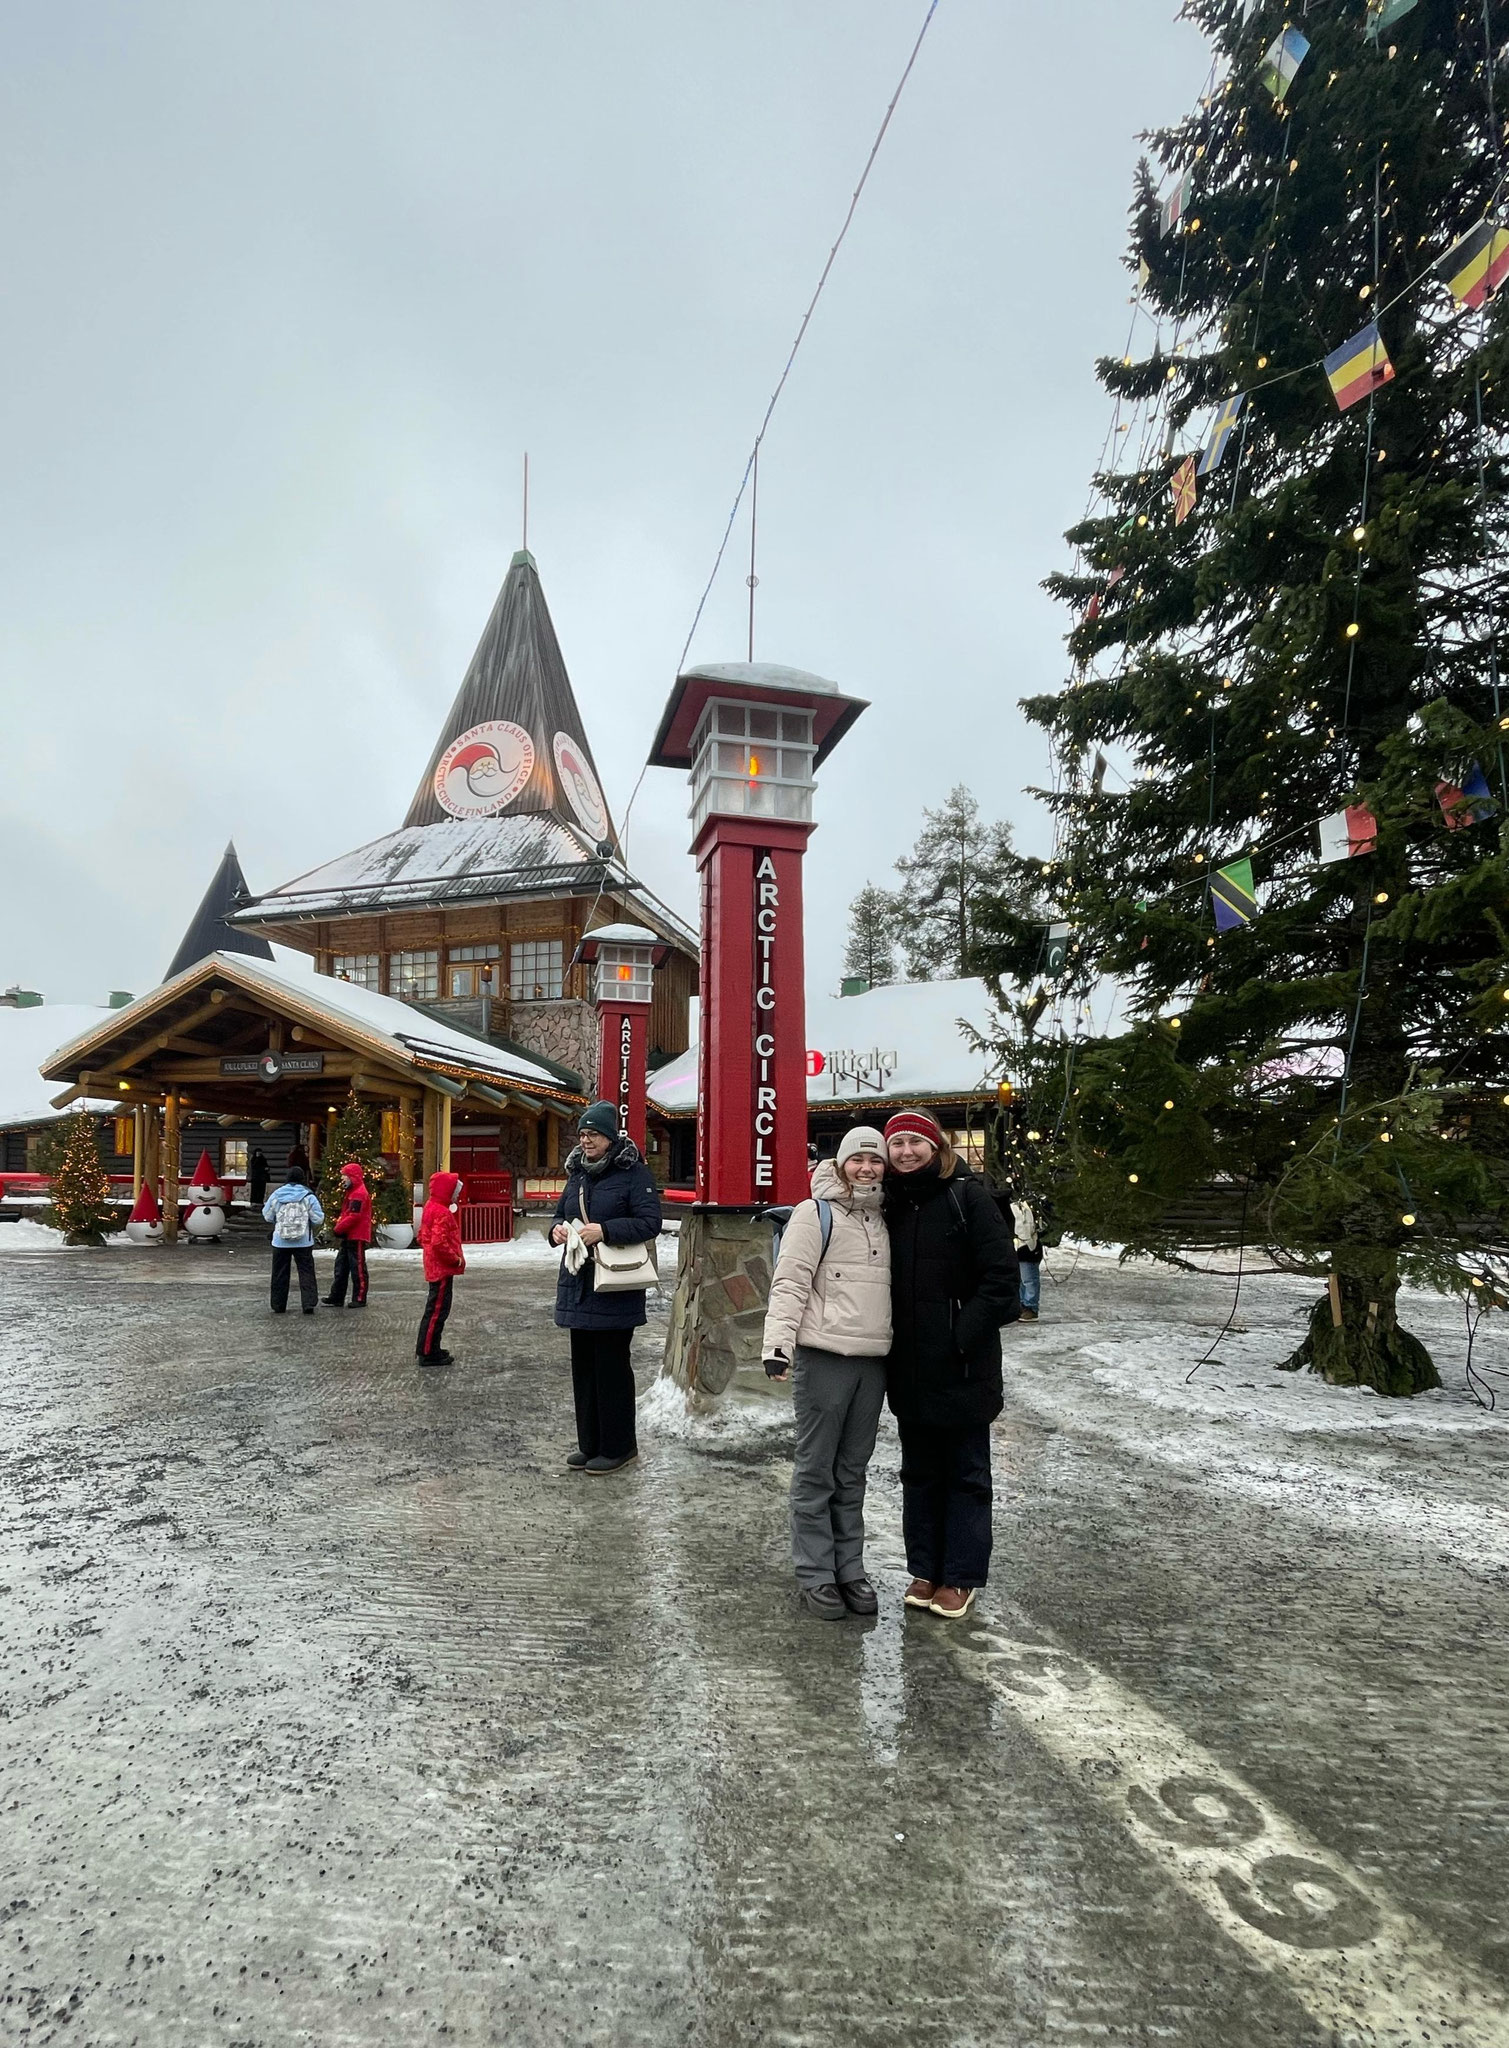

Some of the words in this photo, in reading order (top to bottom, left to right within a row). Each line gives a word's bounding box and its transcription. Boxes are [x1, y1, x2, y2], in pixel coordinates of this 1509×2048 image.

[437, 752, 452, 789] ARCTIC
[457, 724, 493, 747] SANTA
[497, 723, 528, 743] CLAUS
[516, 744, 532, 785] OFFICE
[439, 790, 463, 814] CIRCLE
[465, 793, 512, 816] FINLAND
[756, 856, 779, 1010] ARCTIC
[282, 1061, 299, 1069] SANTA
[300, 1060, 318, 1068] CLAUS
[620, 1018, 631, 1093] ARCTIC
[826, 1047, 897, 1074] iittala
[755, 1034, 777, 1186] CIRCLE
